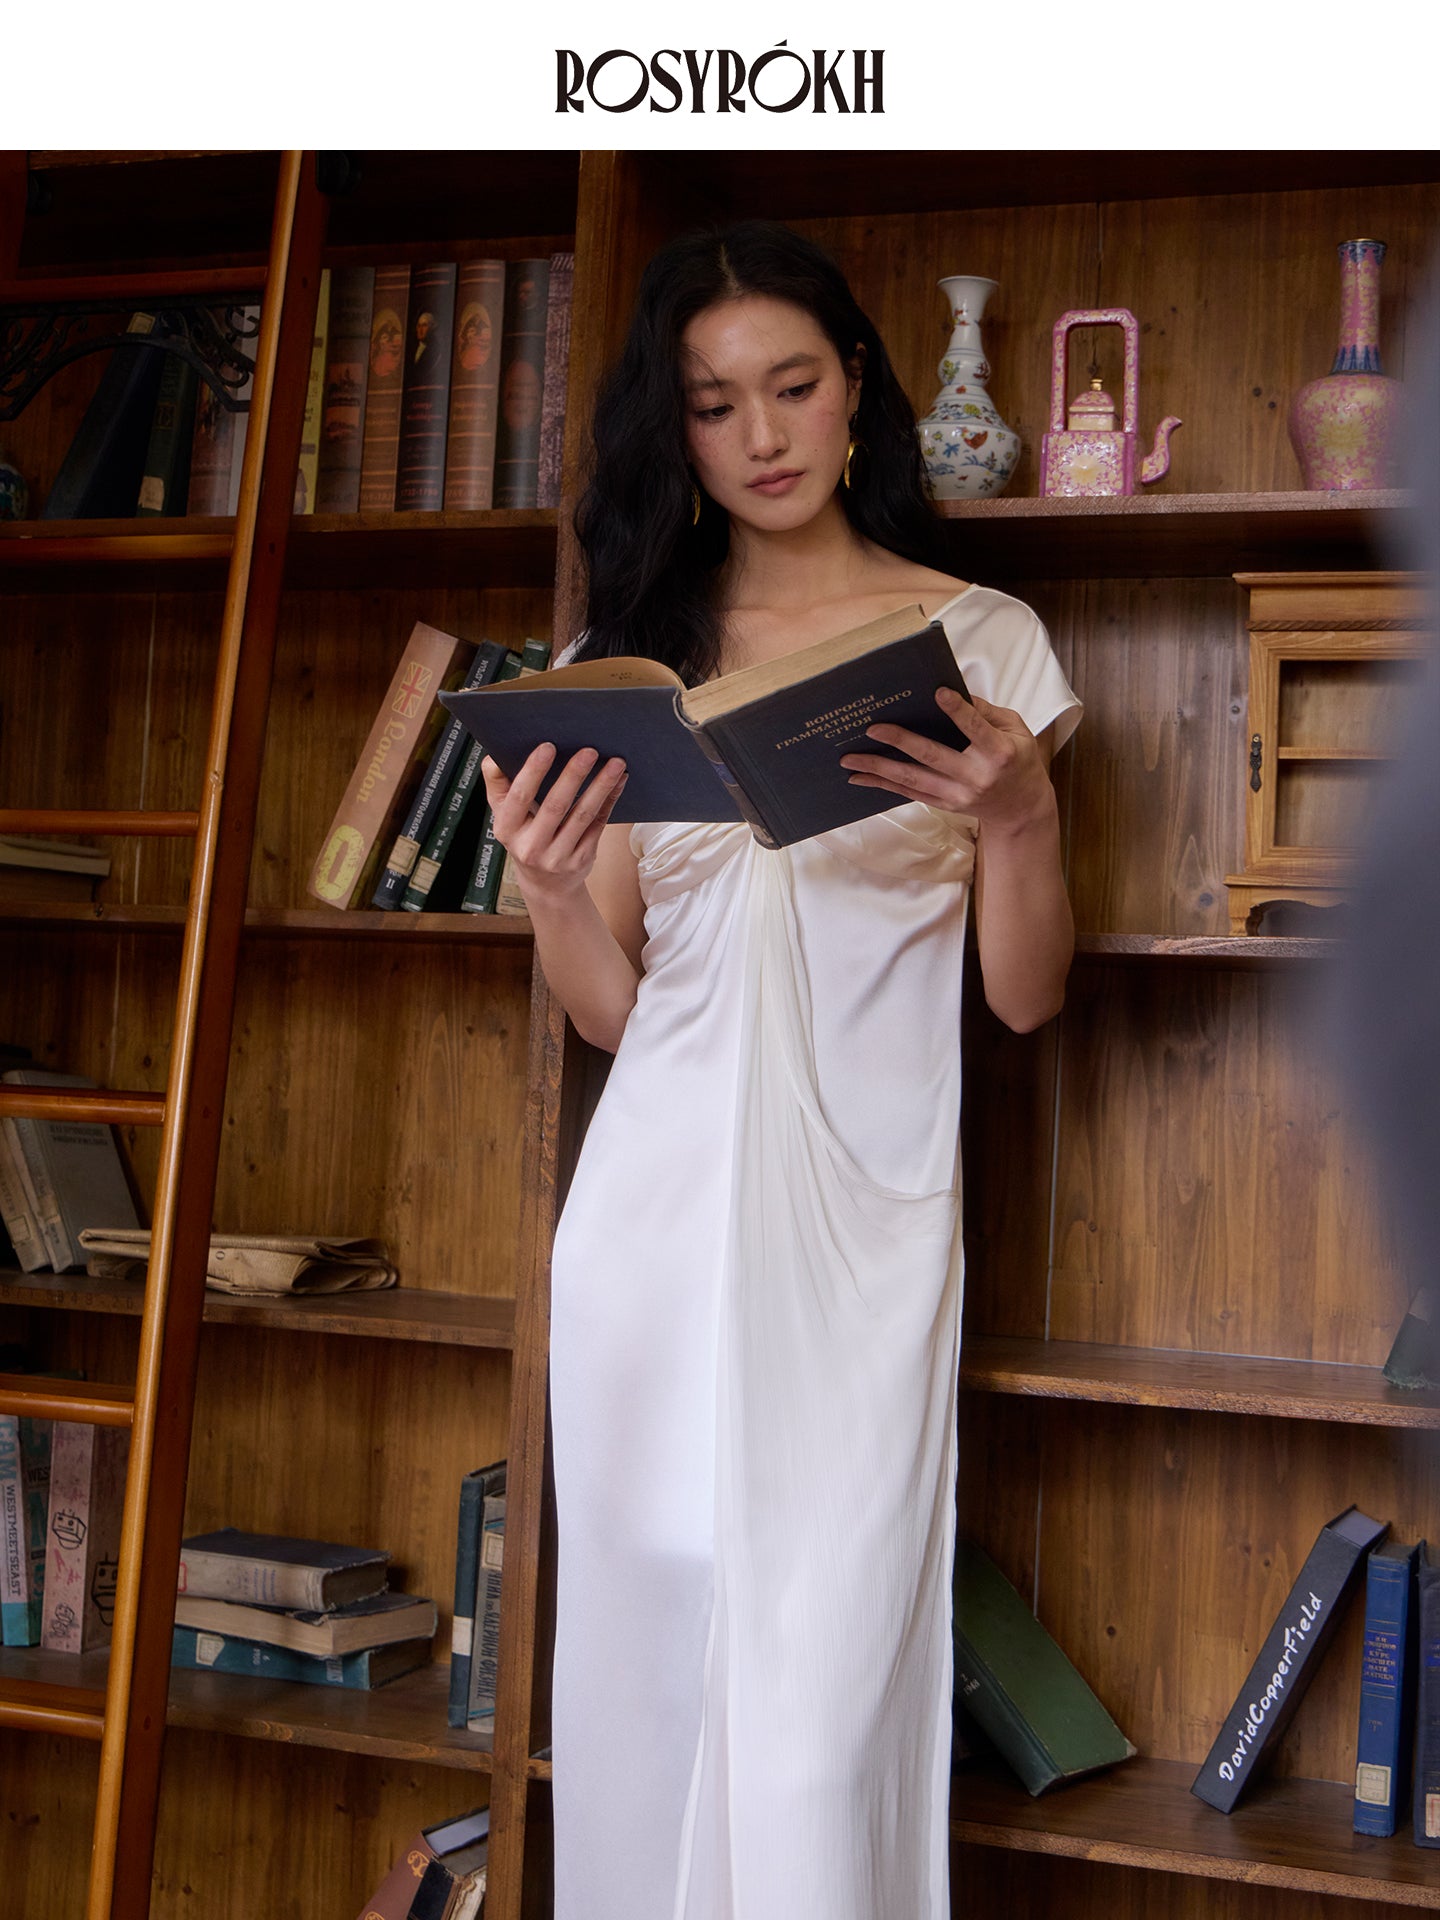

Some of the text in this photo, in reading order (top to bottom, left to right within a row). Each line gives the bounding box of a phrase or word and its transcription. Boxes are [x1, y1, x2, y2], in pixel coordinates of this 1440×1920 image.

[774, 688, 913, 751] ГРАММАТИЧЕСКОГО
[804, 693, 876, 729] ВОПРОСЫ
[823, 715, 873, 740] СТРОЯ
[356, 717, 407, 803] London
[458, 739, 484, 790] OSMOCHIMICA
[407, 786, 435, 841] ЕЖДУНАРОДНОЙ
[474, 844, 494, 889] GEOCHIMICA
[1218, 1591, 1323, 1782] DavidCopperField
